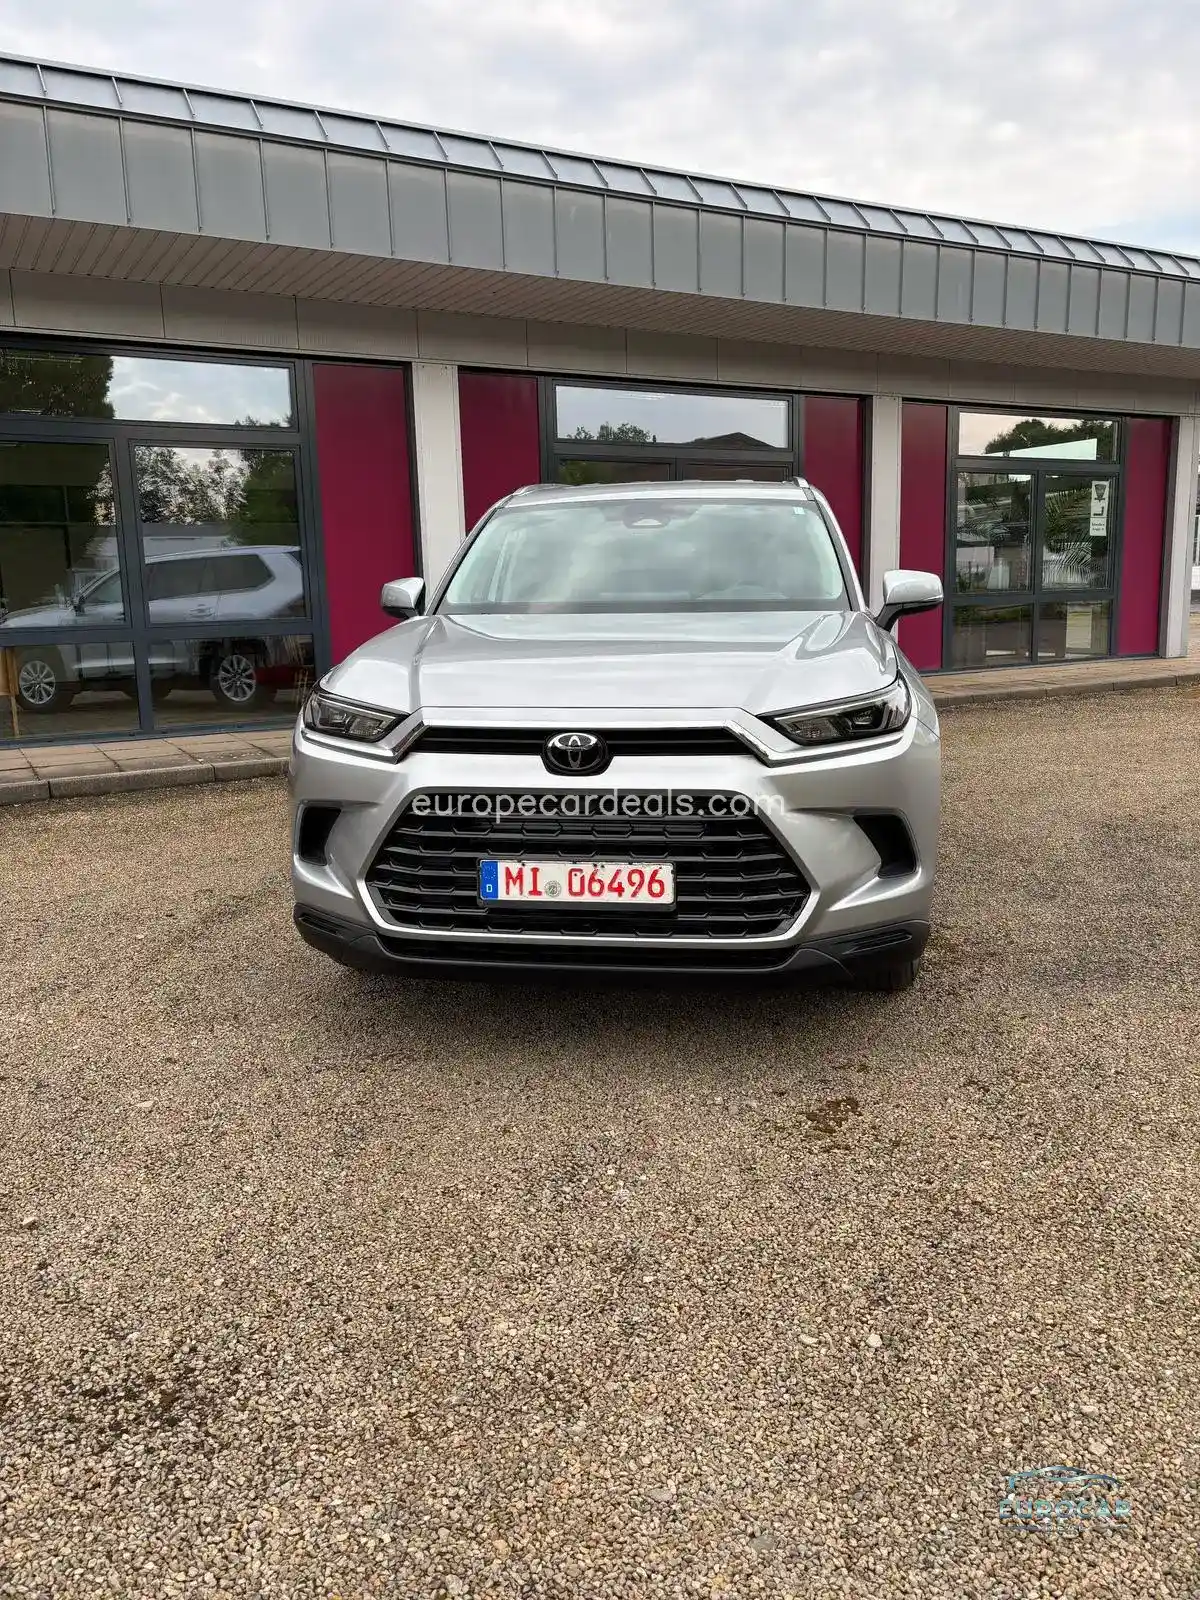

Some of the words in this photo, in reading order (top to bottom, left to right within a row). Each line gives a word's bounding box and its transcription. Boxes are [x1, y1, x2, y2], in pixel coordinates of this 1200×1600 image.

[486, 884, 493, 892] D
[505, 867, 543, 896] MI
[568, 868, 665, 897] 06496
